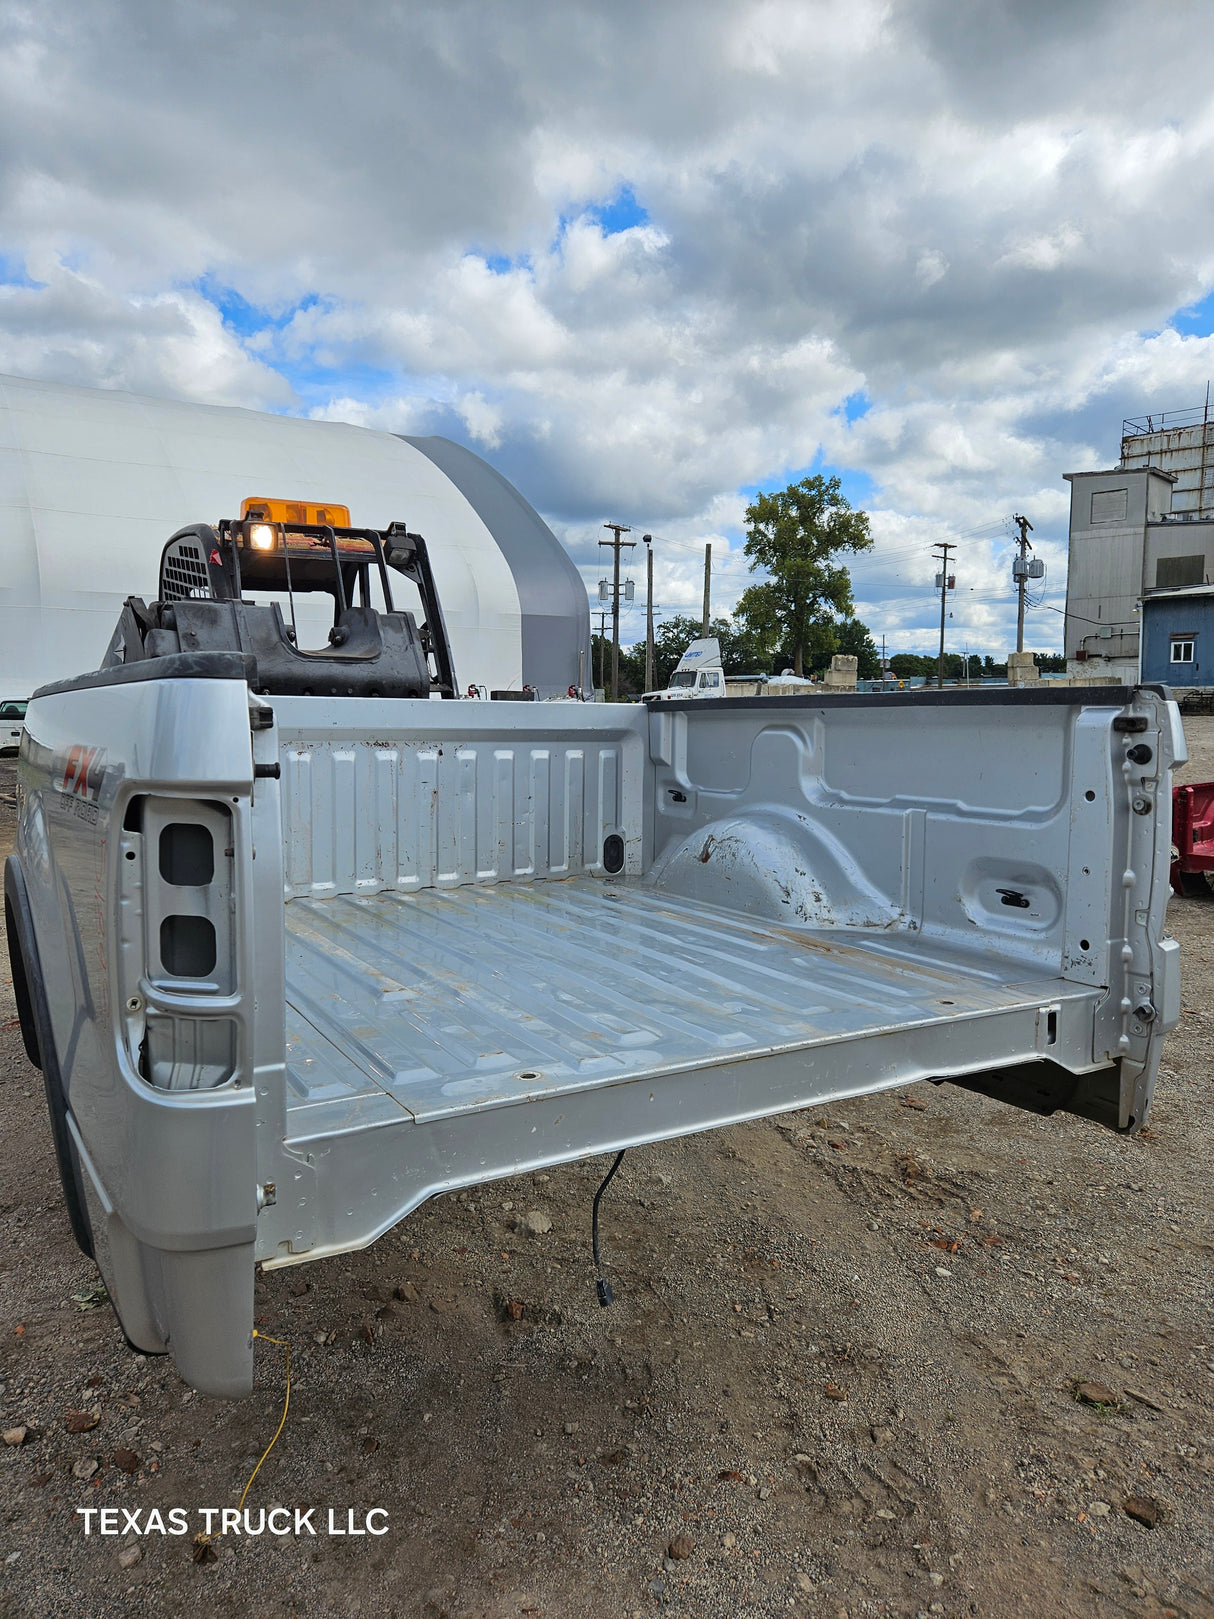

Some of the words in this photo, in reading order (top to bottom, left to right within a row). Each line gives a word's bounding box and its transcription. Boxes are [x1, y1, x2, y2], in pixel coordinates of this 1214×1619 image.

[63, 745, 107, 802] FX4
[60, 793, 74, 812] OFF
[74, 798, 99, 826] ROAD
